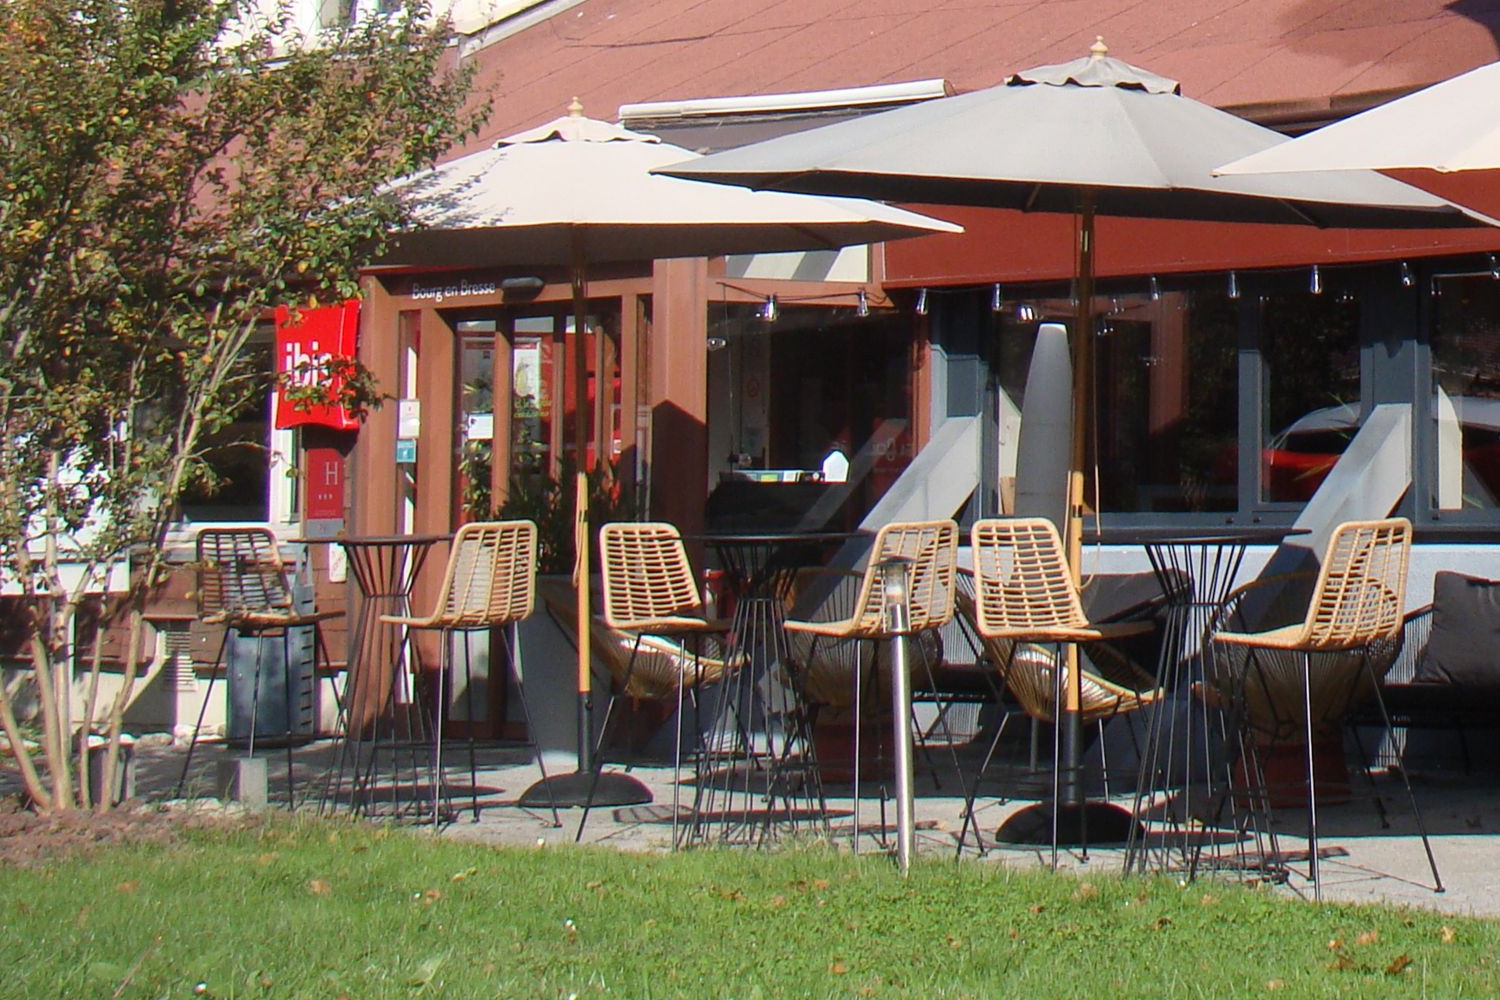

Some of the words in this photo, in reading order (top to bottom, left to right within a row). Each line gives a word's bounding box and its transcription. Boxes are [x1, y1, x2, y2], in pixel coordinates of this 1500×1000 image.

[412, 283, 443, 302] Bourg
[445, 286, 458, 297] en
[460, 279, 496, 296] Bresse
[324, 461, 338, 485] H
